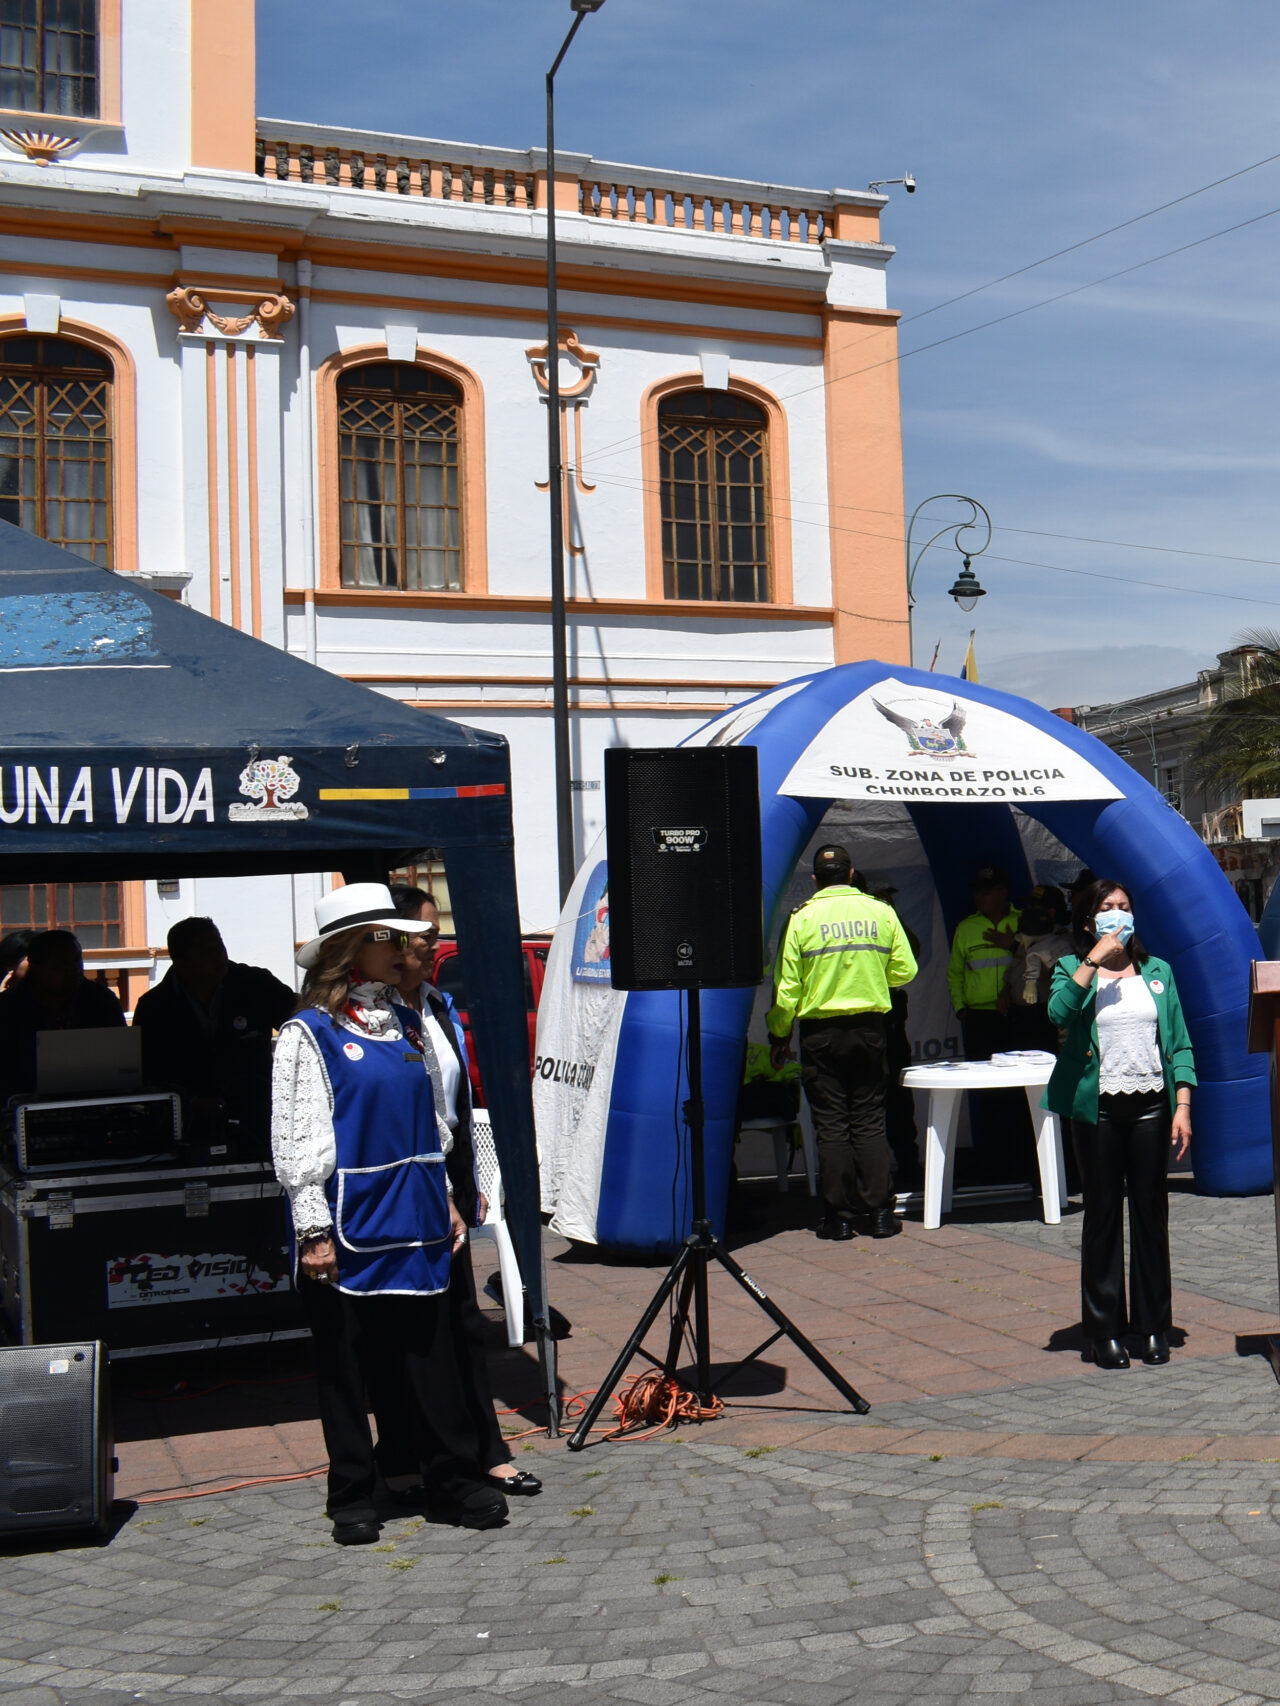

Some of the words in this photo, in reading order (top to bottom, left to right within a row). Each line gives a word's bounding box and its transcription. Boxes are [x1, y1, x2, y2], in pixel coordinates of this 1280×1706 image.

[829, 765, 880, 780] SUB.
[885, 769, 945, 782] ZONA
[950, 770, 977, 782] DE
[983, 768, 1066, 782] POLICIA
[0, 765, 94, 825] UNA
[111, 766, 215, 824] VIDA
[865, 784, 1006, 797] CHIMBORAZO
[1012, 785, 1046, 797] N.6
[665, 836, 695, 844] 900W
[820, 920, 878, 941] POLICIA
[187, 1259, 254, 1279] VISIO
[139, 1287, 191, 1298] DITRONICS
